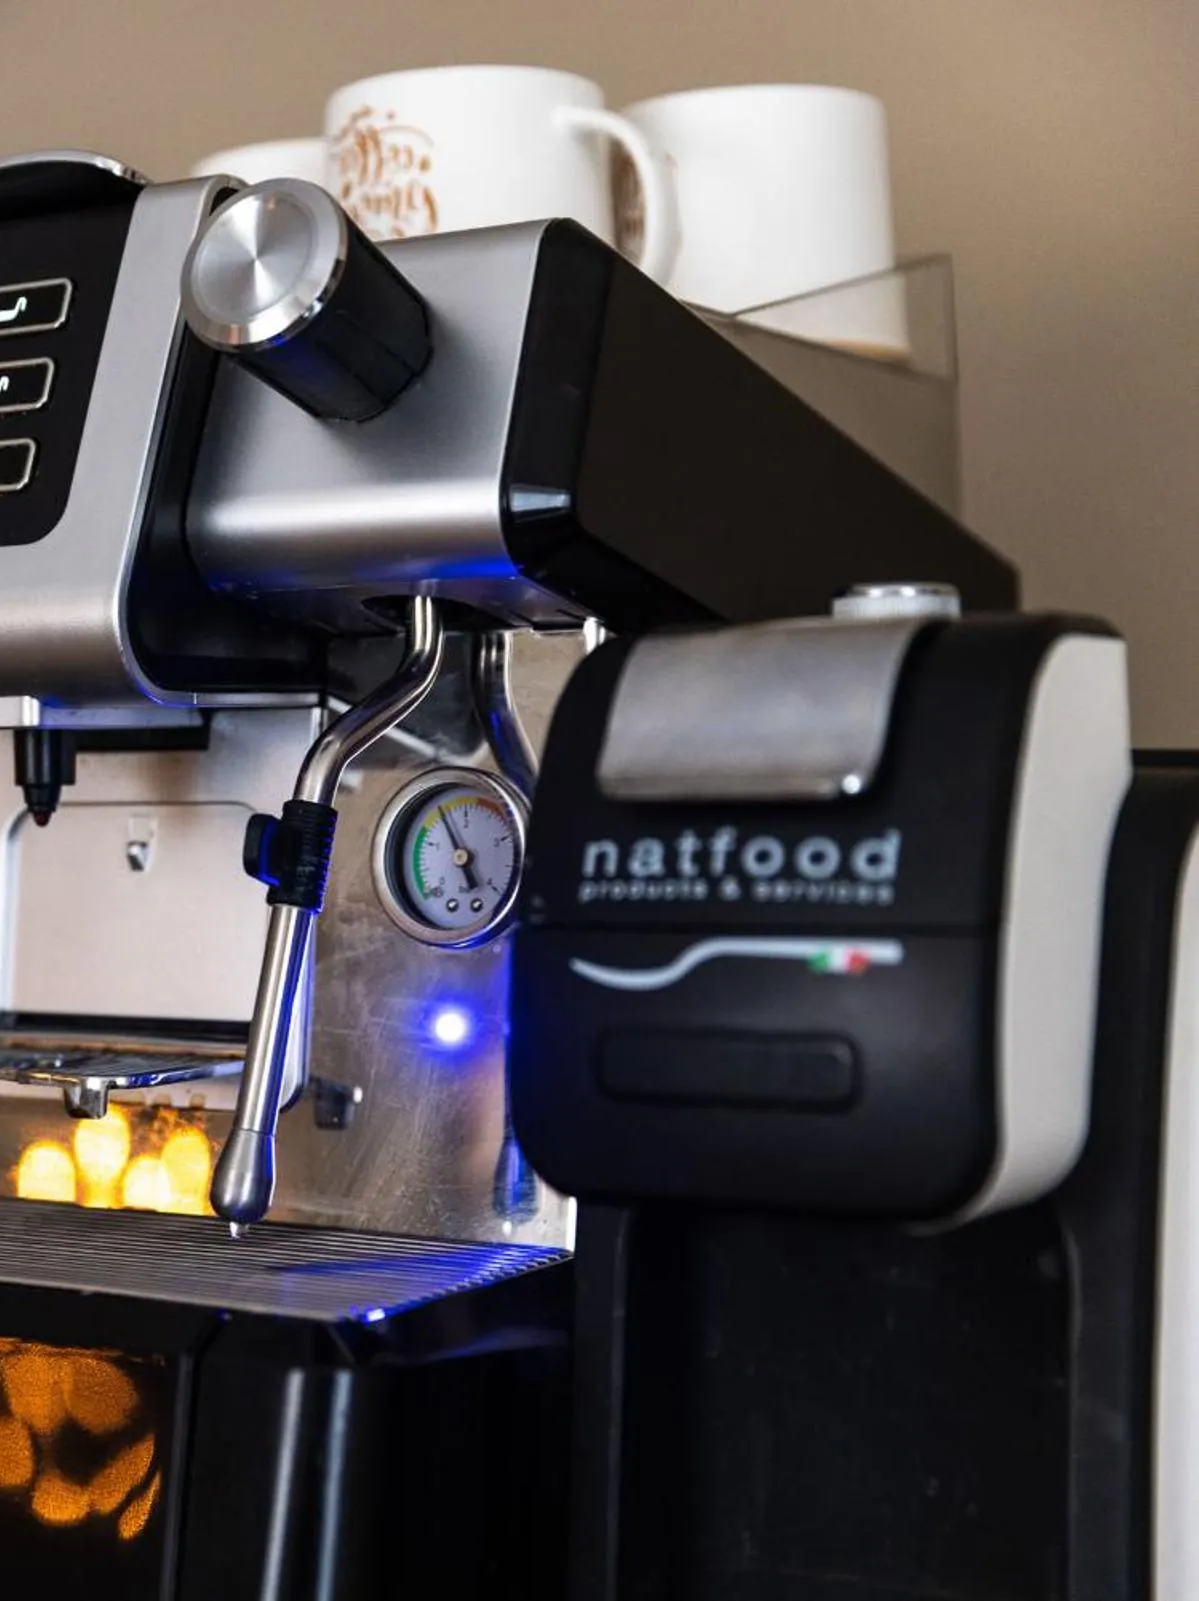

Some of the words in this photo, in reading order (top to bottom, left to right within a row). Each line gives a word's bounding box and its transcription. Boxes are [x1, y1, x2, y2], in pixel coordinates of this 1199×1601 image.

[582, 825, 900, 880] natfood
[578, 878, 707, 903] products
[752, 879, 895, 905] services
